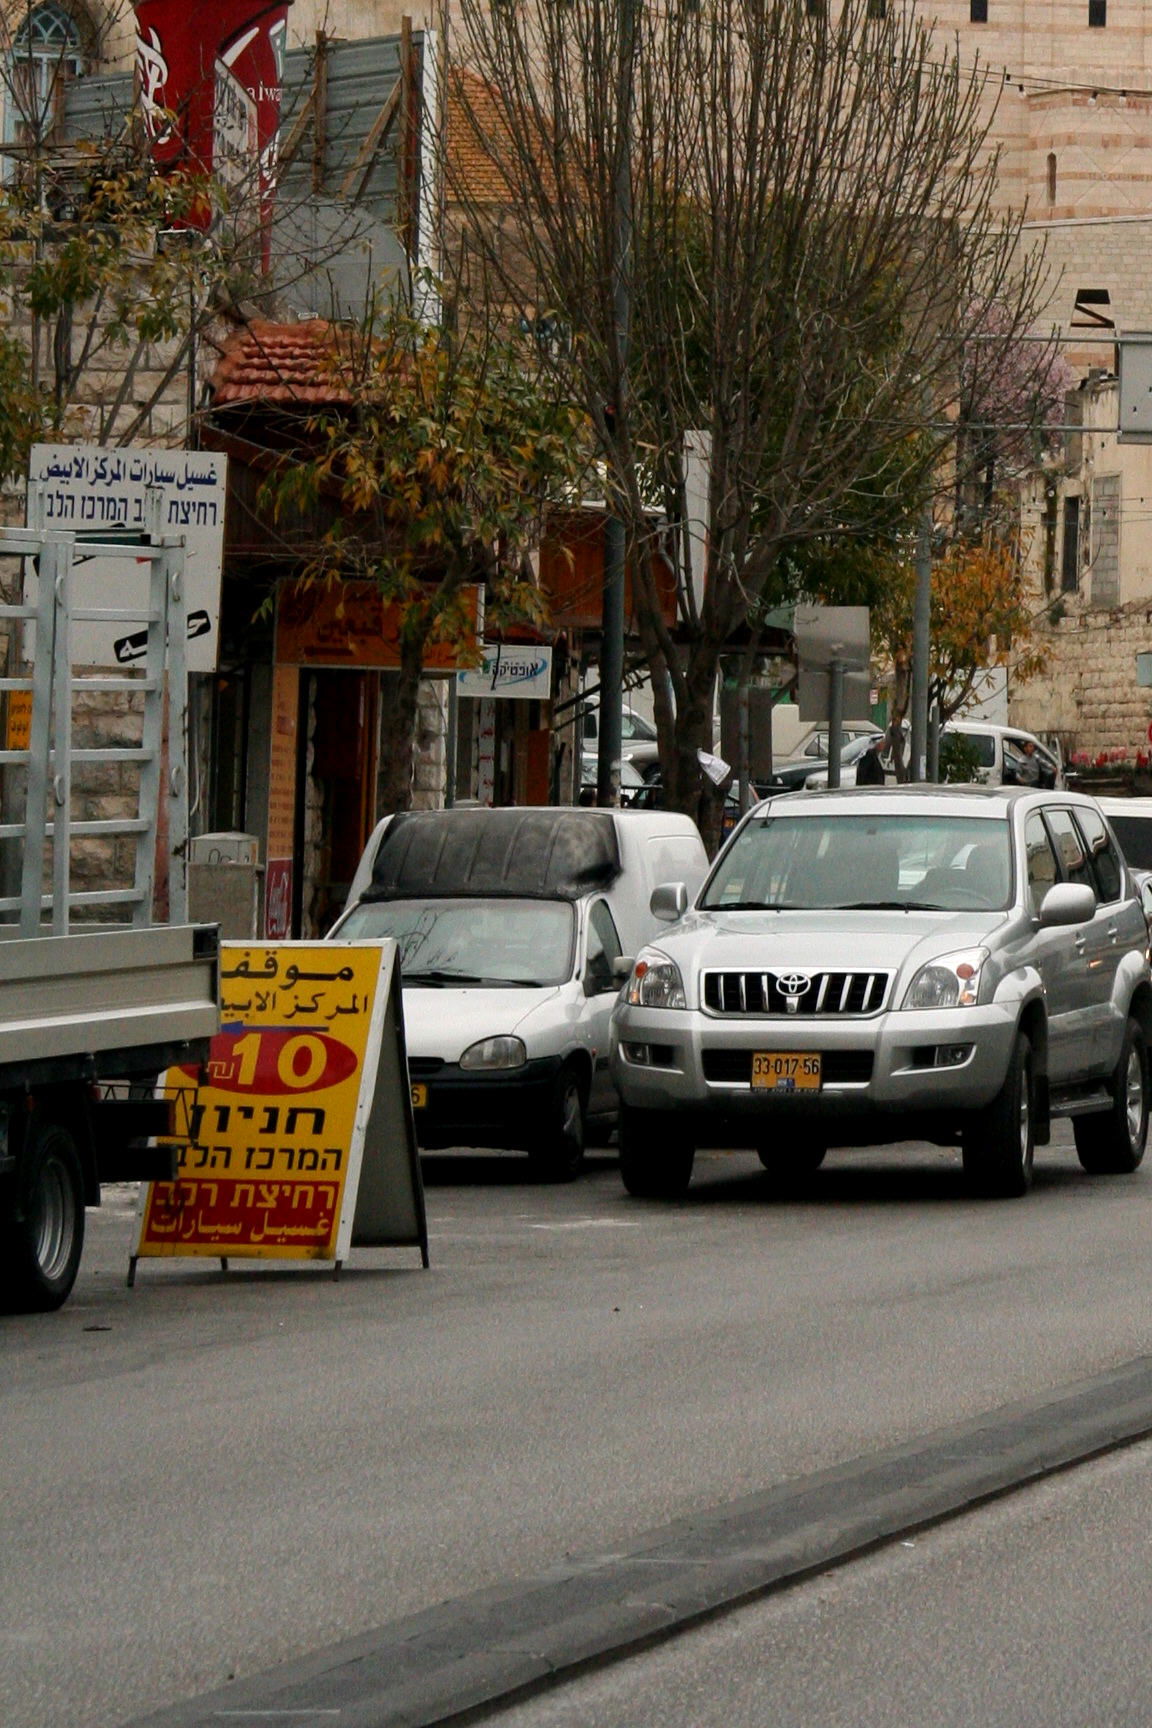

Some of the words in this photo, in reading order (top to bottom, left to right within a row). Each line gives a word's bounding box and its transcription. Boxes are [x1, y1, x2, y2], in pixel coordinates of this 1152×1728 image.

[88, 456, 126, 486] المركز
[176, 462, 217, 491] غسيل
[47, 490, 75, 519] הלב
[81, 495, 128, 522] המרכז
[168, 500, 217, 526] רחיצת
[221, 991, 276, 1018] الابي
[283, 992, 368, 1020] المركز
[232, 1033, 327, 1088] 10
[190, 1104, 326, 1135] חניון
[245, 1148, 342, 1171] המרכז
[155, 1182, 218, 1208] רכב
[230, 1183, 336, 1209] רחיצת
[250, 1209, 329, 1242] غسيل
